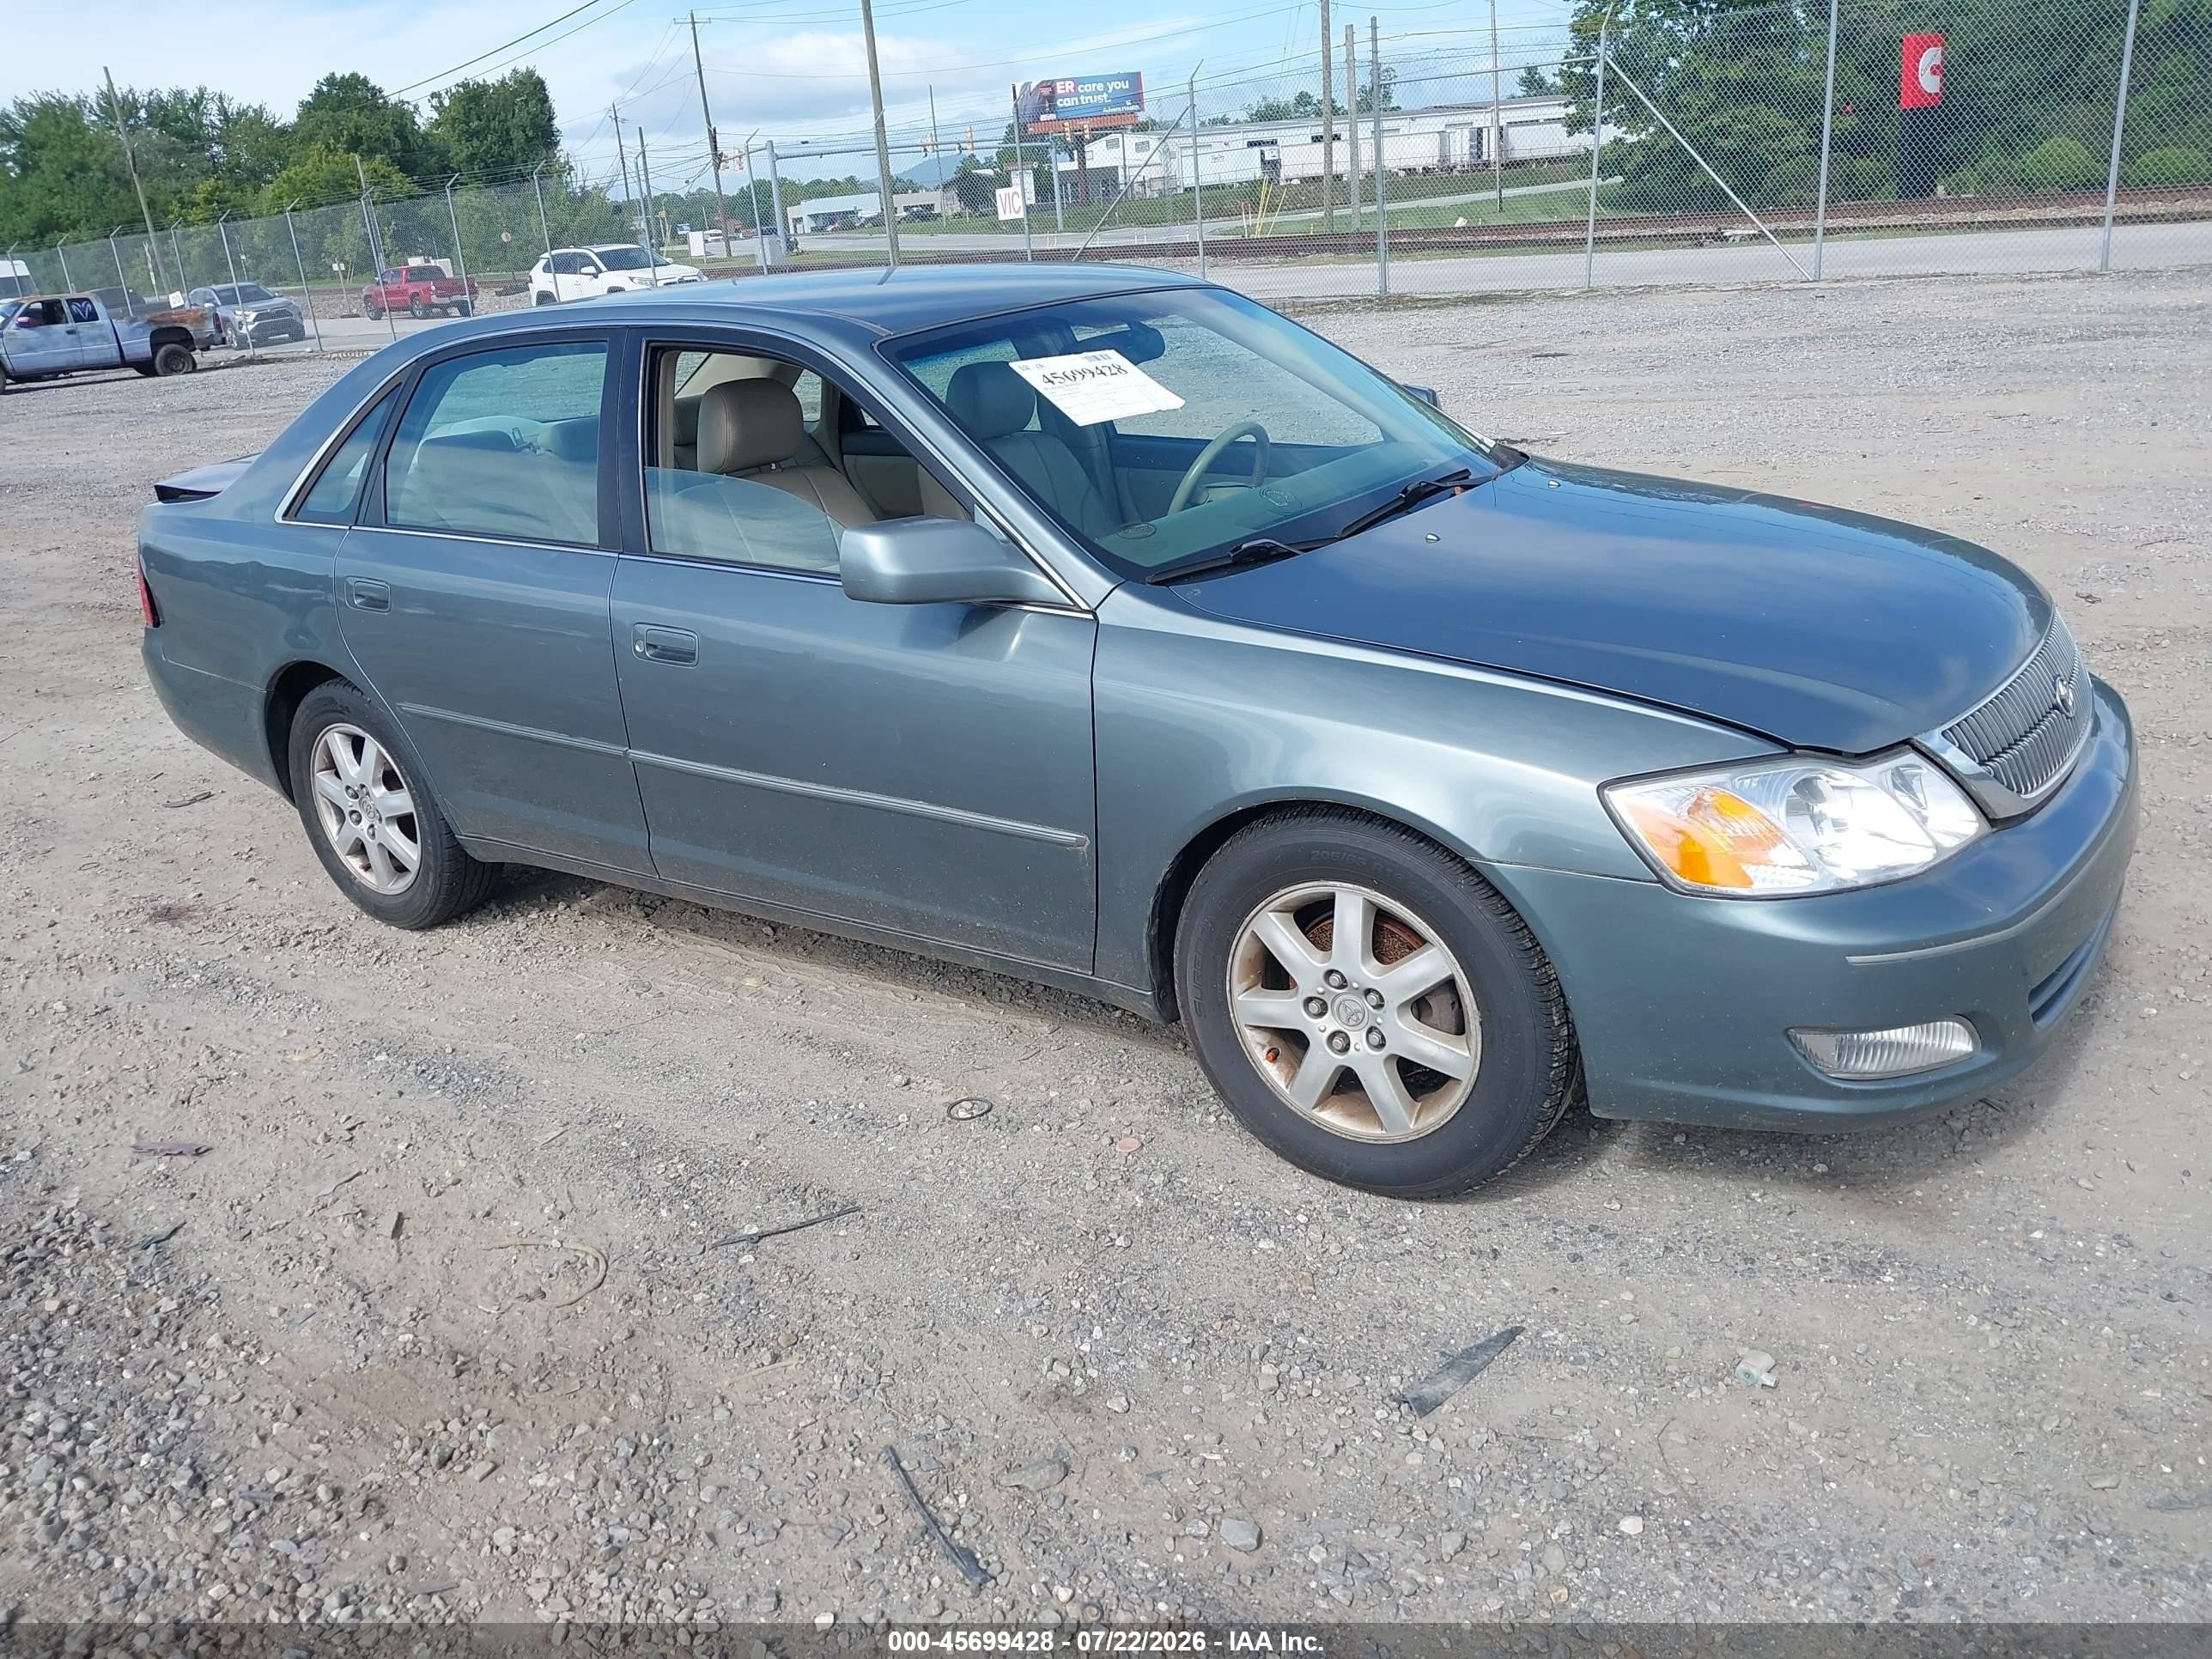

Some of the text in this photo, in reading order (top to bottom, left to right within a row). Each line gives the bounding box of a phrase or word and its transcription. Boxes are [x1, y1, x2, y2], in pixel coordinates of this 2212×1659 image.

[1056, 81, 1075, 94] ER
[1078, 82, 1104, 93] care
[1107, 80, 1129, 93] you
[1057, 92, 1112, 106] can trust.
[999, 191, 1022, 216] VIC
[1042, 363, 1128, 385] 45699428
